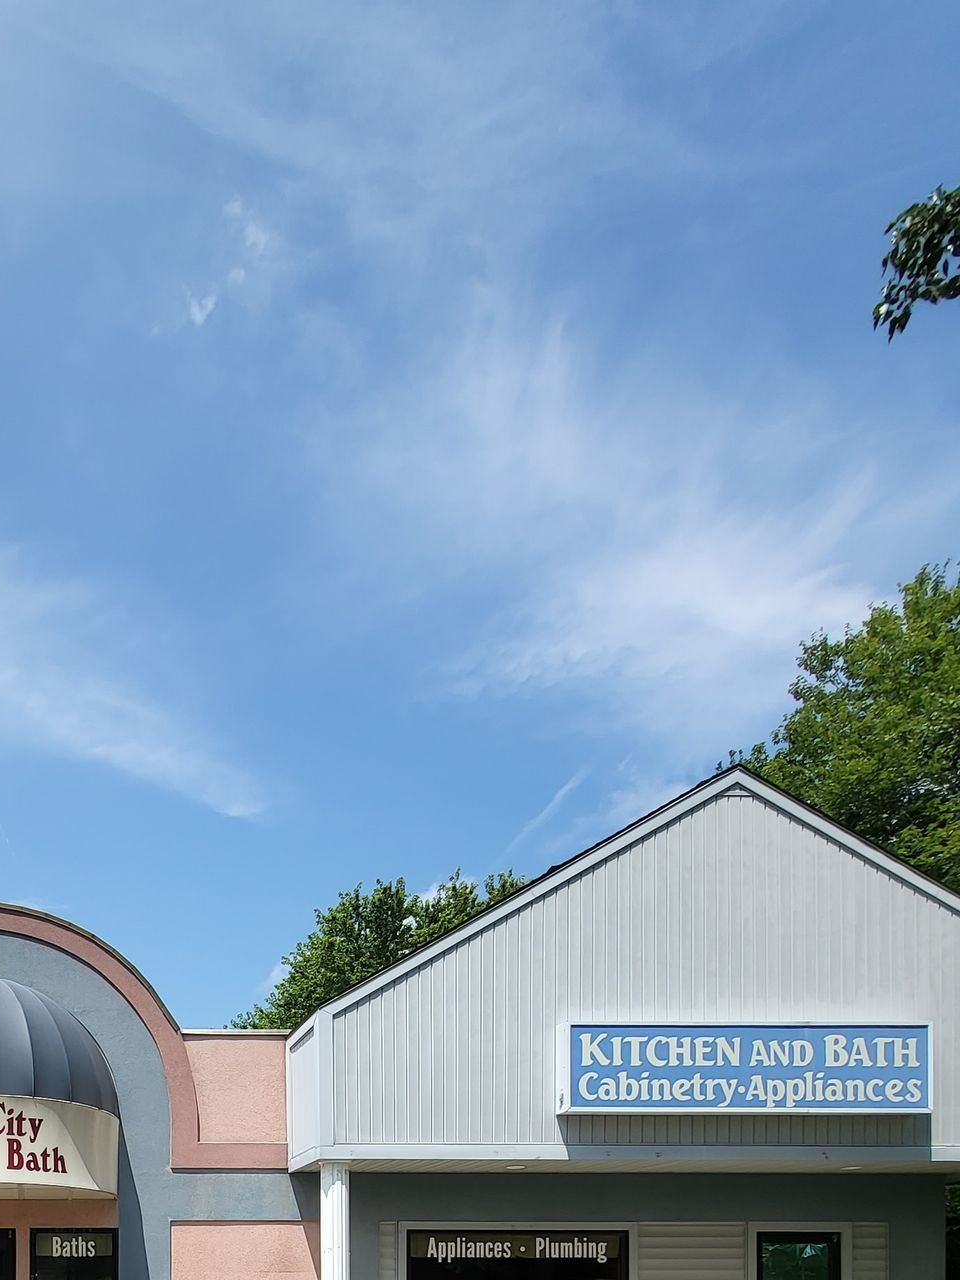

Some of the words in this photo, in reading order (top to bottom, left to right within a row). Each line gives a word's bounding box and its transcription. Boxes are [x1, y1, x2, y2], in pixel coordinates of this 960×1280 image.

[578, 1033, 741, 1067] KITCHEN
[749, 1039, 814, 1067] AND
[823, 1034, 921, 1068] BATH
[6, 1138, 68, 1174] Bath
[52, 1236, 96, 1257] Baths
[426, 1237, 512, 1263] Appliances
[535, 1237, 608, 1263] Plumbing
